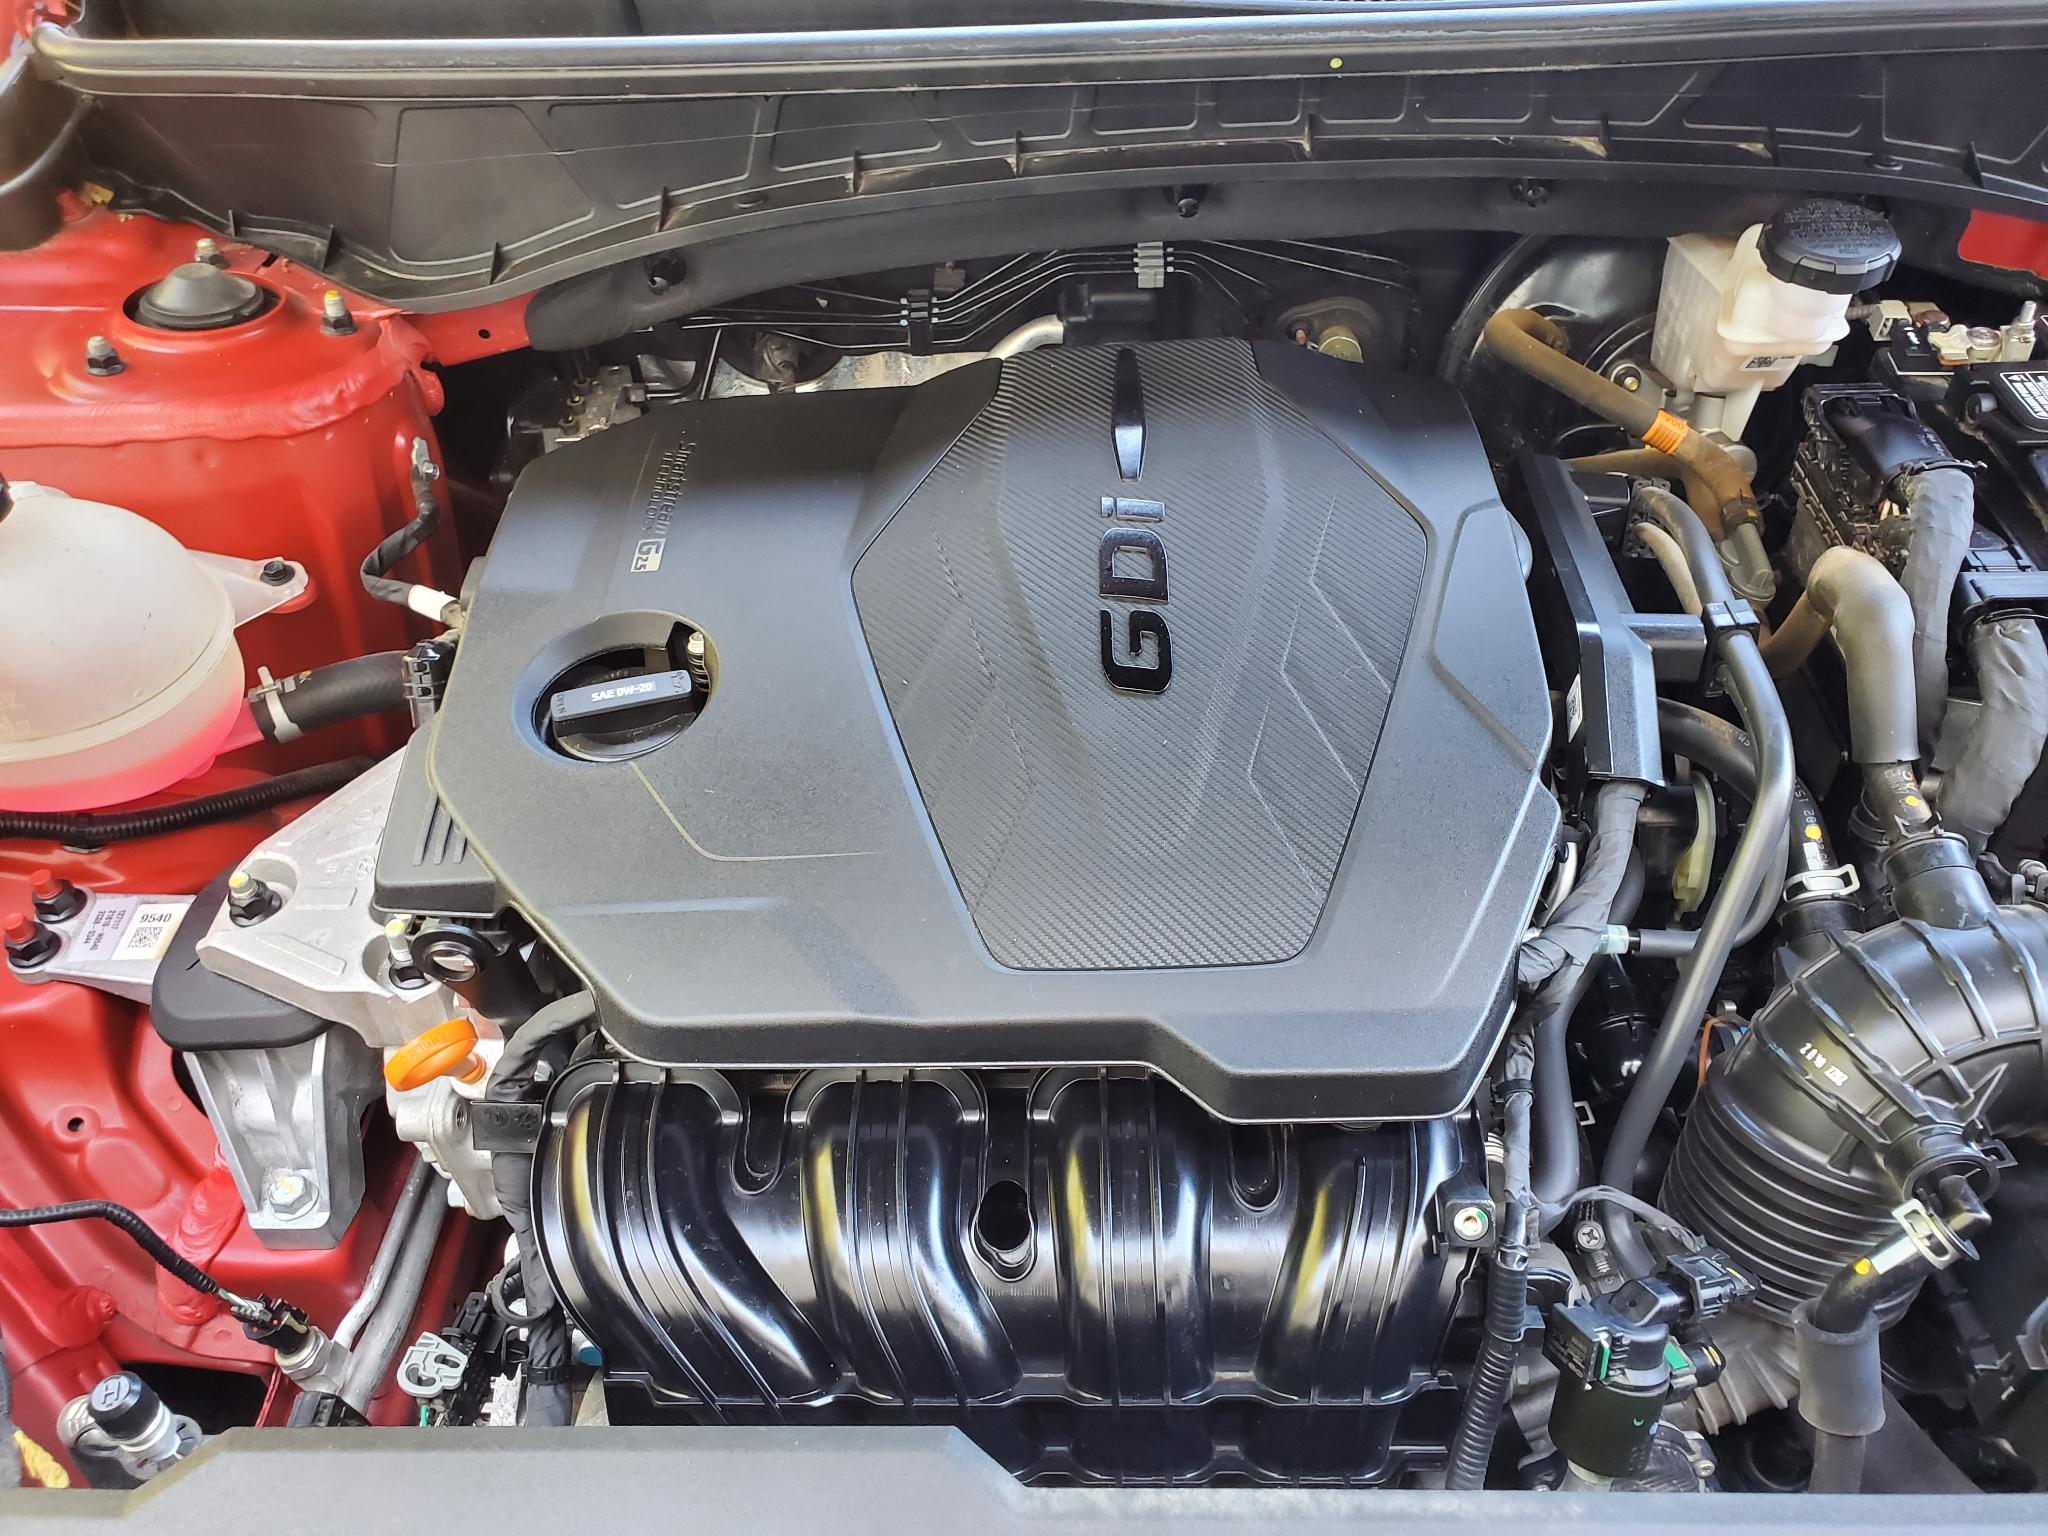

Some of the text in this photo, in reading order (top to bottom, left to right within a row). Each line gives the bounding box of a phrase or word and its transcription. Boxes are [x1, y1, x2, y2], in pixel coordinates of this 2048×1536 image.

[642, 451, 674, 531] TECHNOLOGY
[655, 441, 696, 535] Smartstream
[1100, 497, 1173, 694] GDi
[592, 689, 616, 702] SAE
[140, 913, 172, 924] 9540
